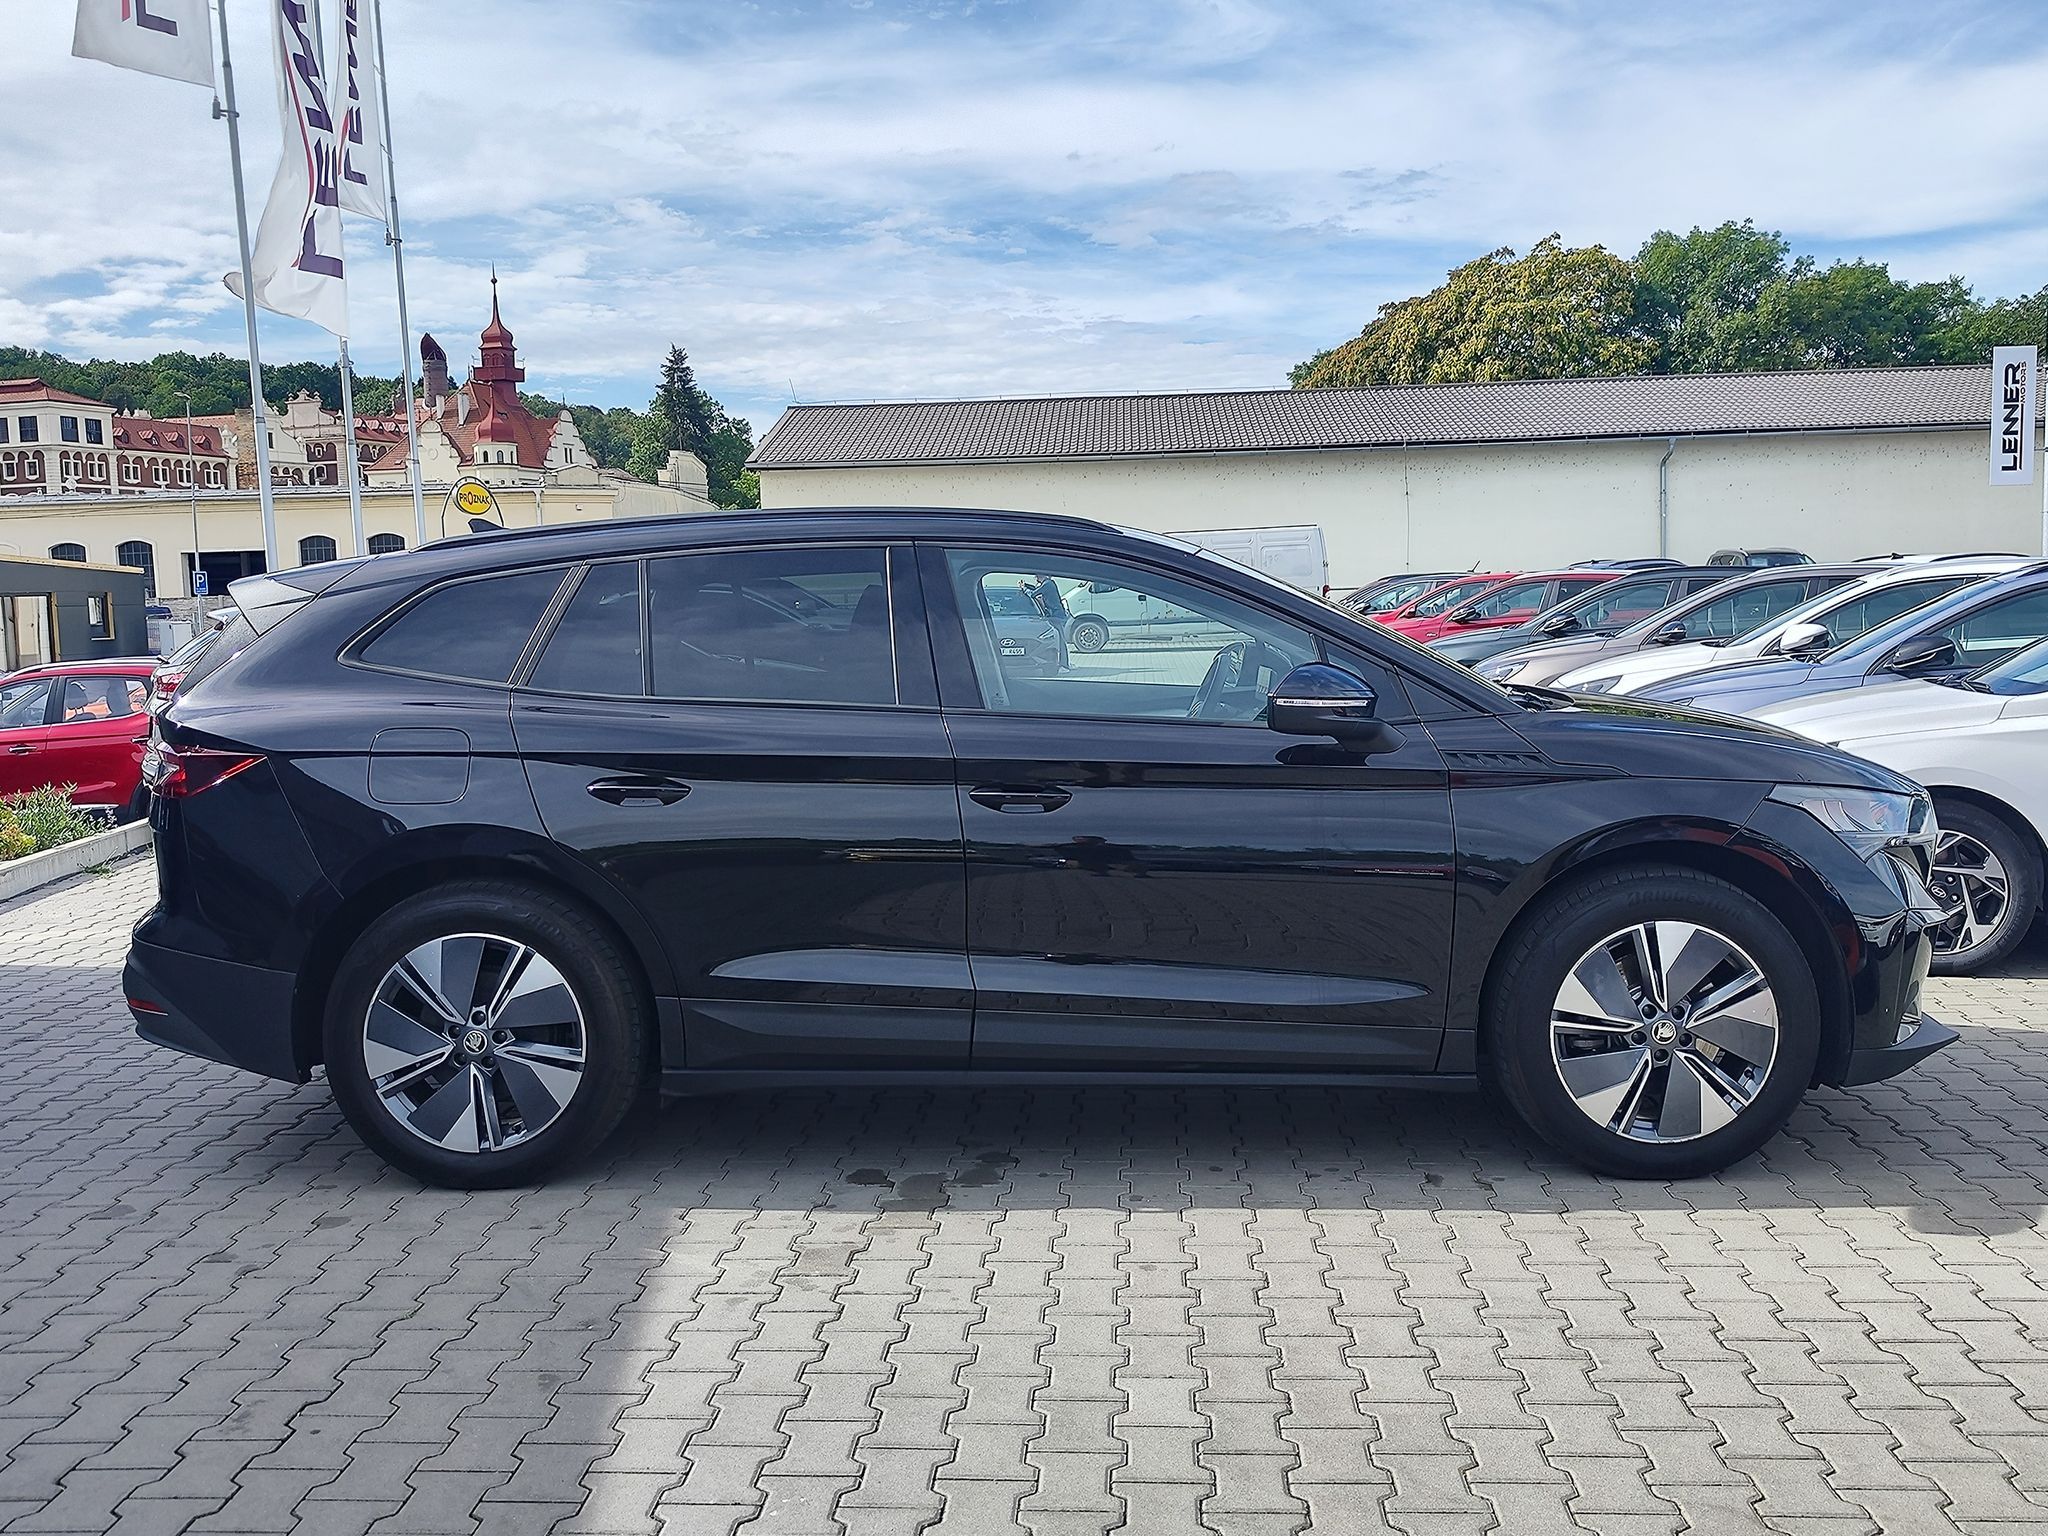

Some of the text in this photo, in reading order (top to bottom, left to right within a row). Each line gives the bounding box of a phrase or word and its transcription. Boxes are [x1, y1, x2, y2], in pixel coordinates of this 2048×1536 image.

[2001, 362, 2020, 471] LENNER
[459, 491, 490, 505] PROZNAK
[196, 574, 204, 587] P
